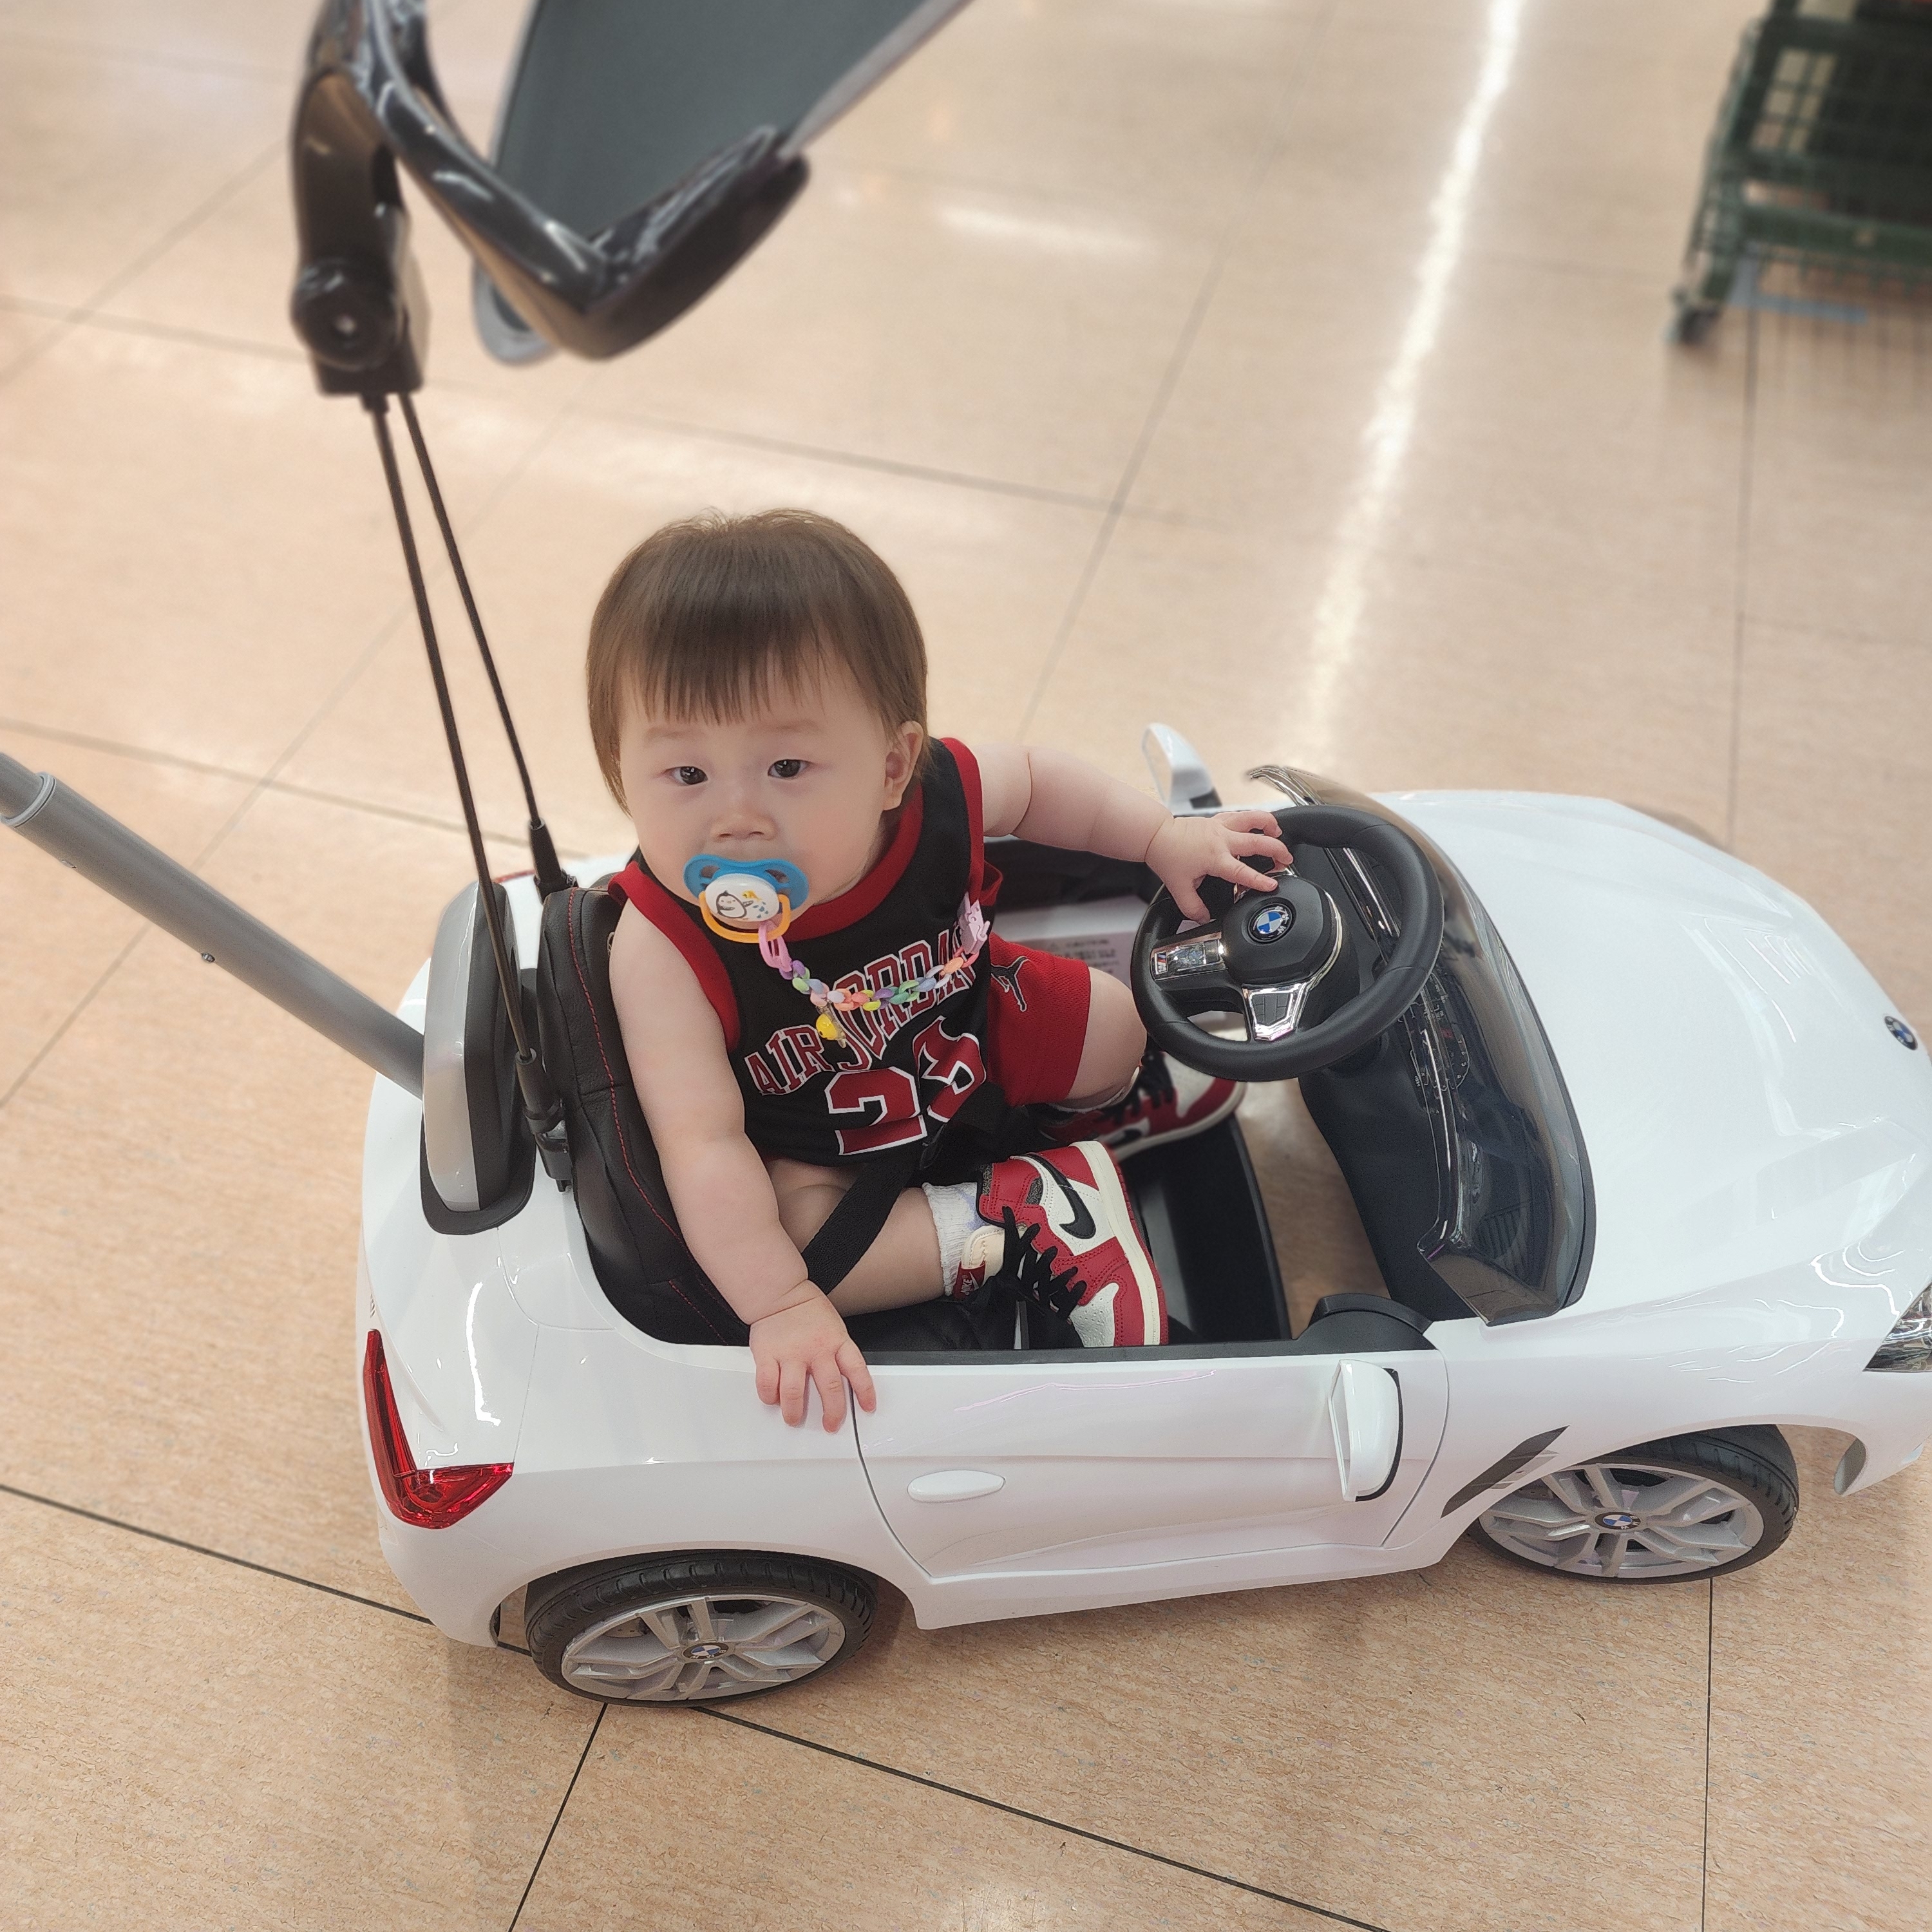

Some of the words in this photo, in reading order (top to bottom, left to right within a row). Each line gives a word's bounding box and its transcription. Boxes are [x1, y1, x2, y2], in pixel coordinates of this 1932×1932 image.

[744, 1024, 837, 1096] AIR
[824, 1016, 987, 1156] 23
[960, 1278, 972, 1296] NIKE
